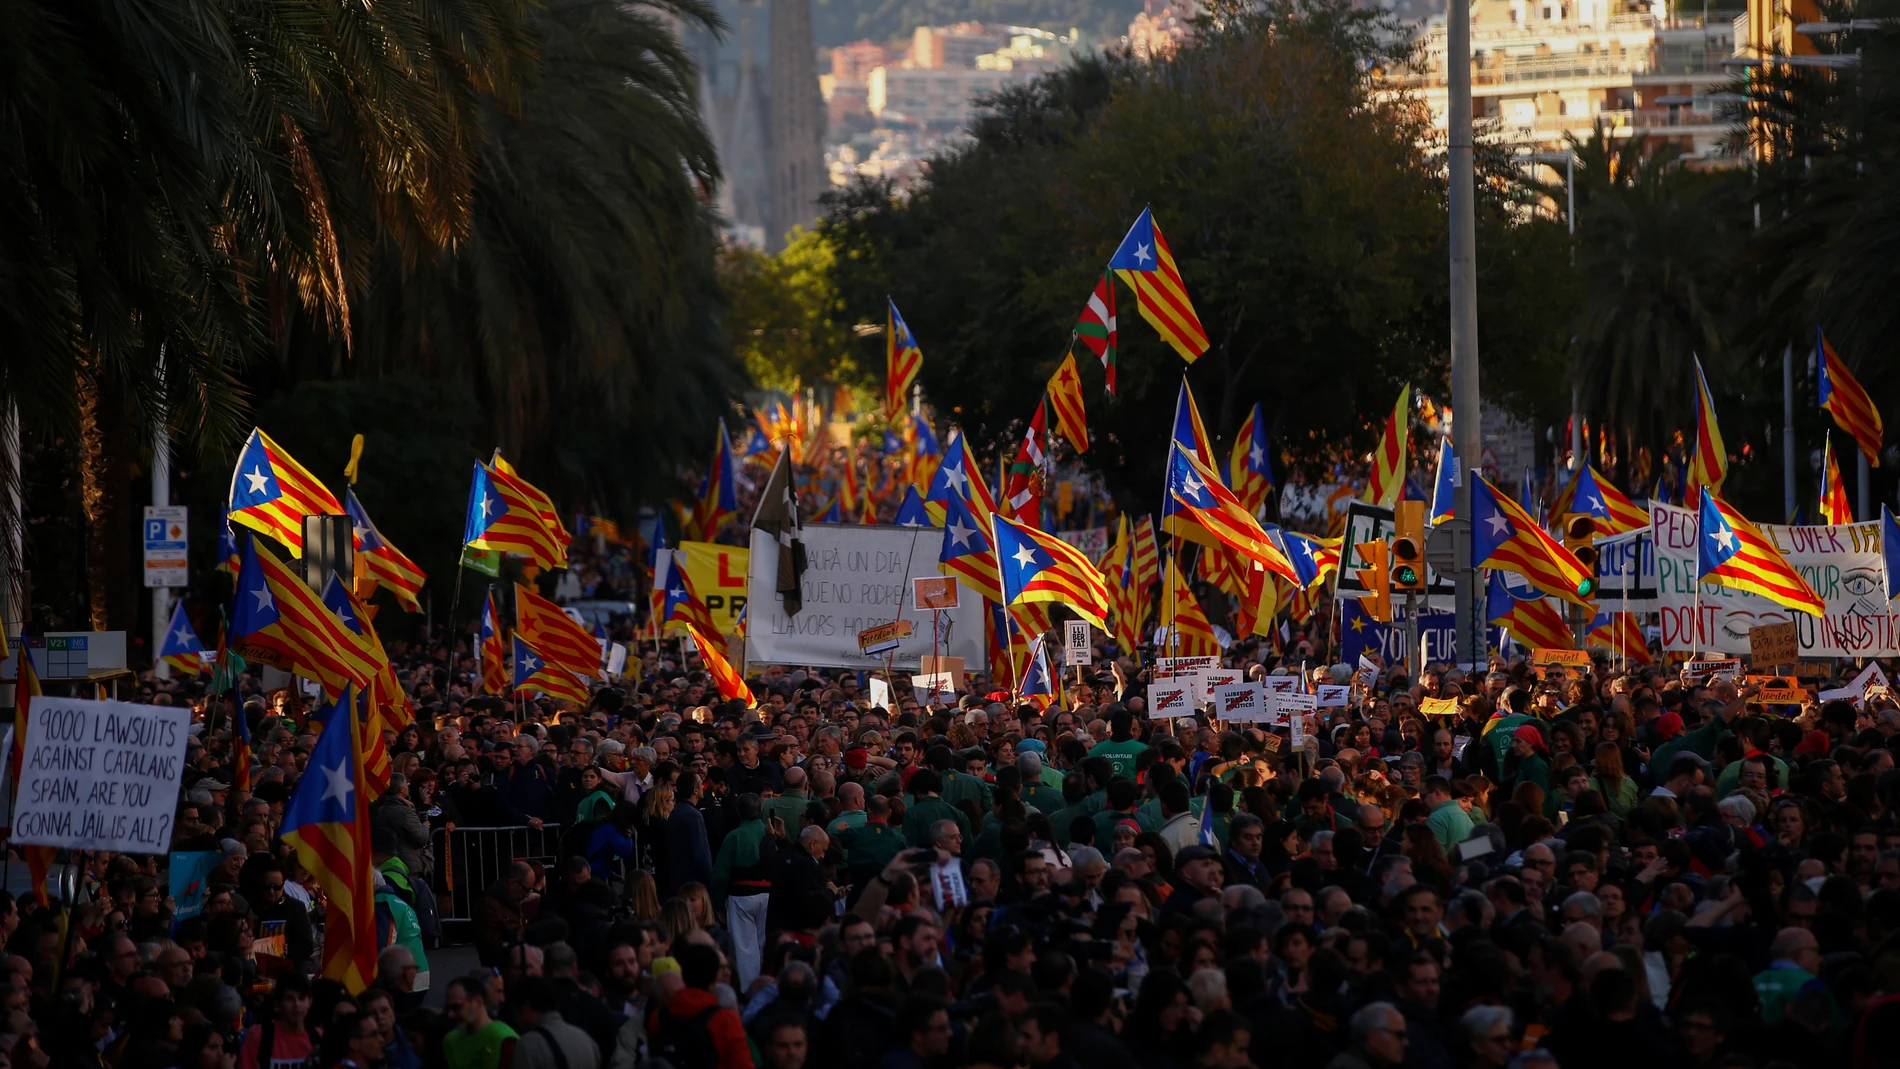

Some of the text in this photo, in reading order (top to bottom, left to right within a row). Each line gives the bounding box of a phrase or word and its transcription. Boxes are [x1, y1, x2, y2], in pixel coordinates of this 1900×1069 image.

[150, 521, 162, 540] P
[1788, 526, 1846, 553] OVER
[847, 550, 870, 573] UN
[875, 550, 902, 573] DIA
[832, 582, 852, 604] NO
[772, 613, 835, 636] LLAVORS
[1660, 600, 1723, 648] DON'T
[1783, 608, 1815, 649] TO
[50, 639, 67, 648] V21
[900, 652, 921, 661] Estell
[103, 749, 177, 781] CATALANS
[87, 781, 119, 806] ARE
[122, 782, 151, 808] YOU
[16, 811, 71, 838] GONNA
[111, 815, 127, 839] US
